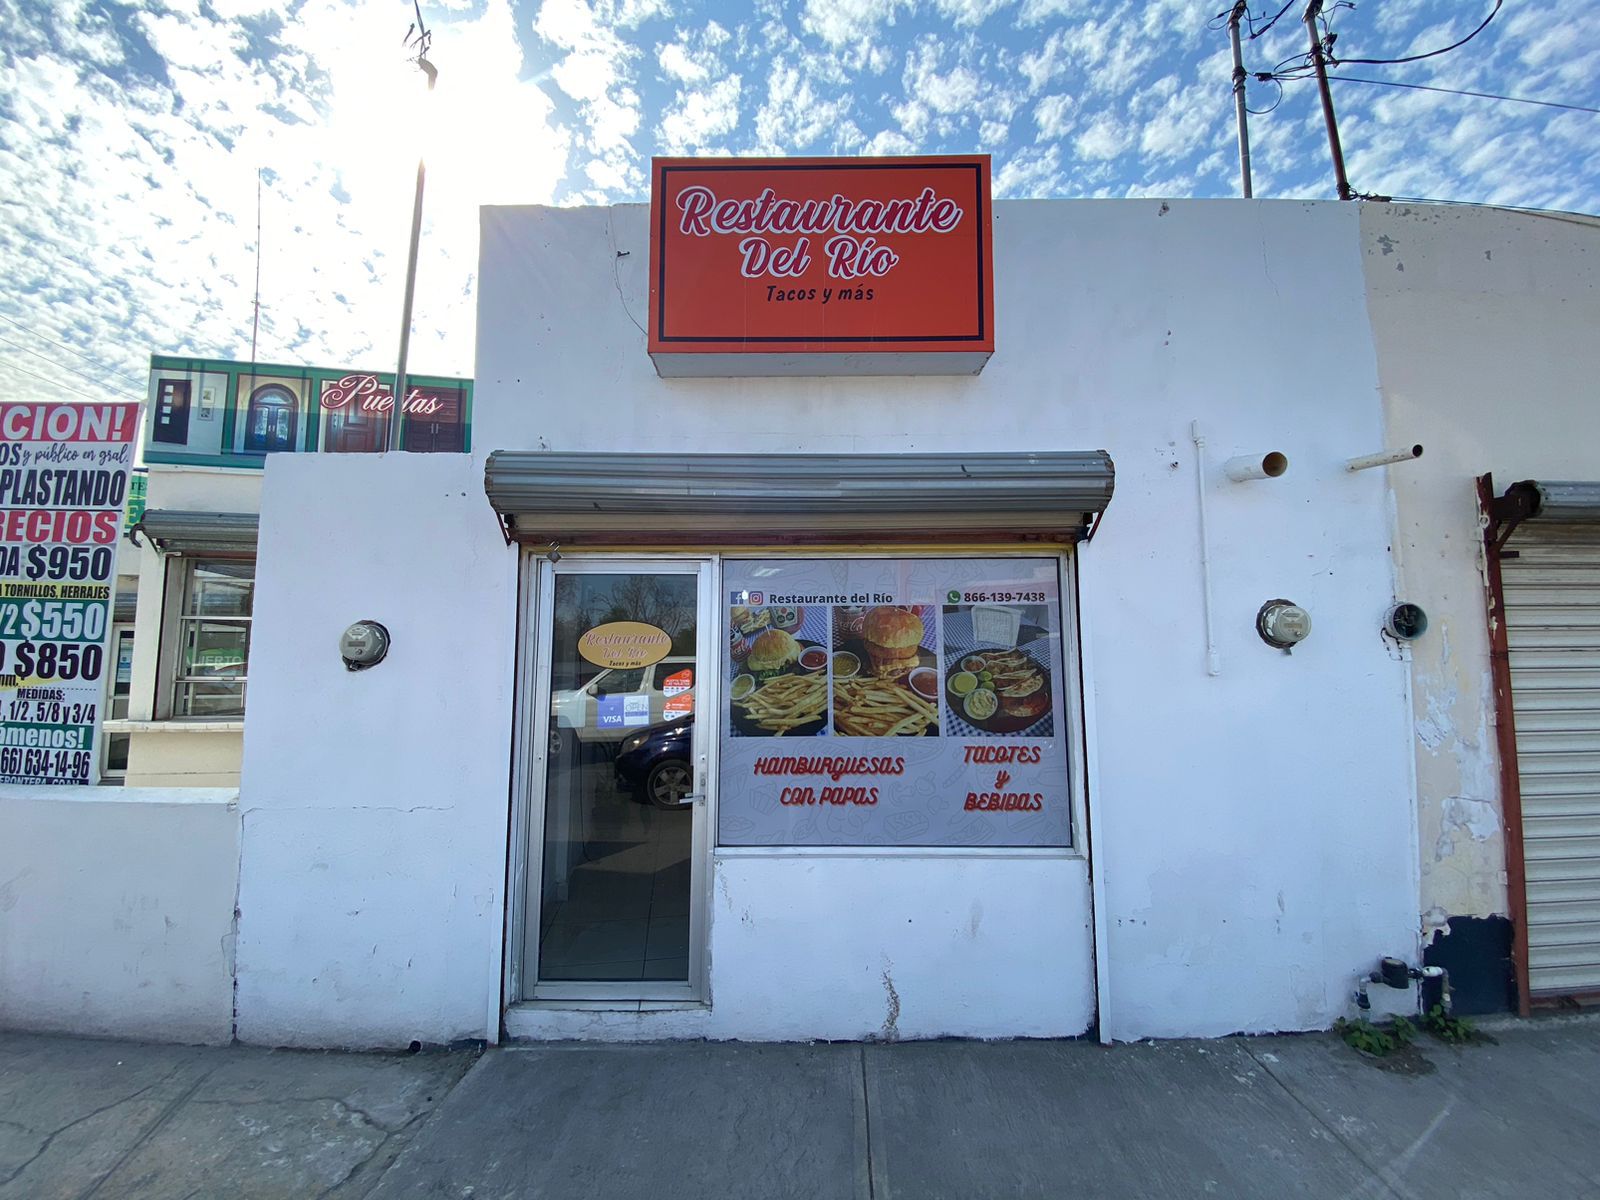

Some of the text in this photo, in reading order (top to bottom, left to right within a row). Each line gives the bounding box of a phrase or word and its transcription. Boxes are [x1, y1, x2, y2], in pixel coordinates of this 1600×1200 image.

[676, 186, 964, 236] Restaurante
[739, 234, 899, 280] Del Río
[766, 283, 875, 304] Tacos y más
[321, 375, 443, 414] Puetas
[22, 448, 33, 467] y
[35, 443, 79, 464] público
[82, 450, 97, 462] en
[99, 443, 129, 466] gral.
[0, 469, 127, 507] PLASTANDO
[26, 544, 112, 581] $950
[5, 584, 59, 599] TORNILLOS,
[60, 585, 110, 599] HERRAJES
[769, 592, 894, 603] Restaurante del Río
[963, 592, 1046, 602] 866-139-7438
[20, 599, 105, 640] $550
[14, 639, 103, 681] $850
[17, 688, 66, 701] MEDIDAS:
[37, 702, 61, 722] 5/8
[62, 706, 71, 724] y
[72, 703, 96, 724] 3/4
[603, 715, 623, 723] VISA
[24, 748, 91, 779] 634-14-96
[963, 745, 1042, 764] TACOTES
[753, 756, 906, 782] HAMBURGUESAS
[779, 786, 879, 806] CON PAPAS
[963, 792, 1044, 812] BEBIDAS
